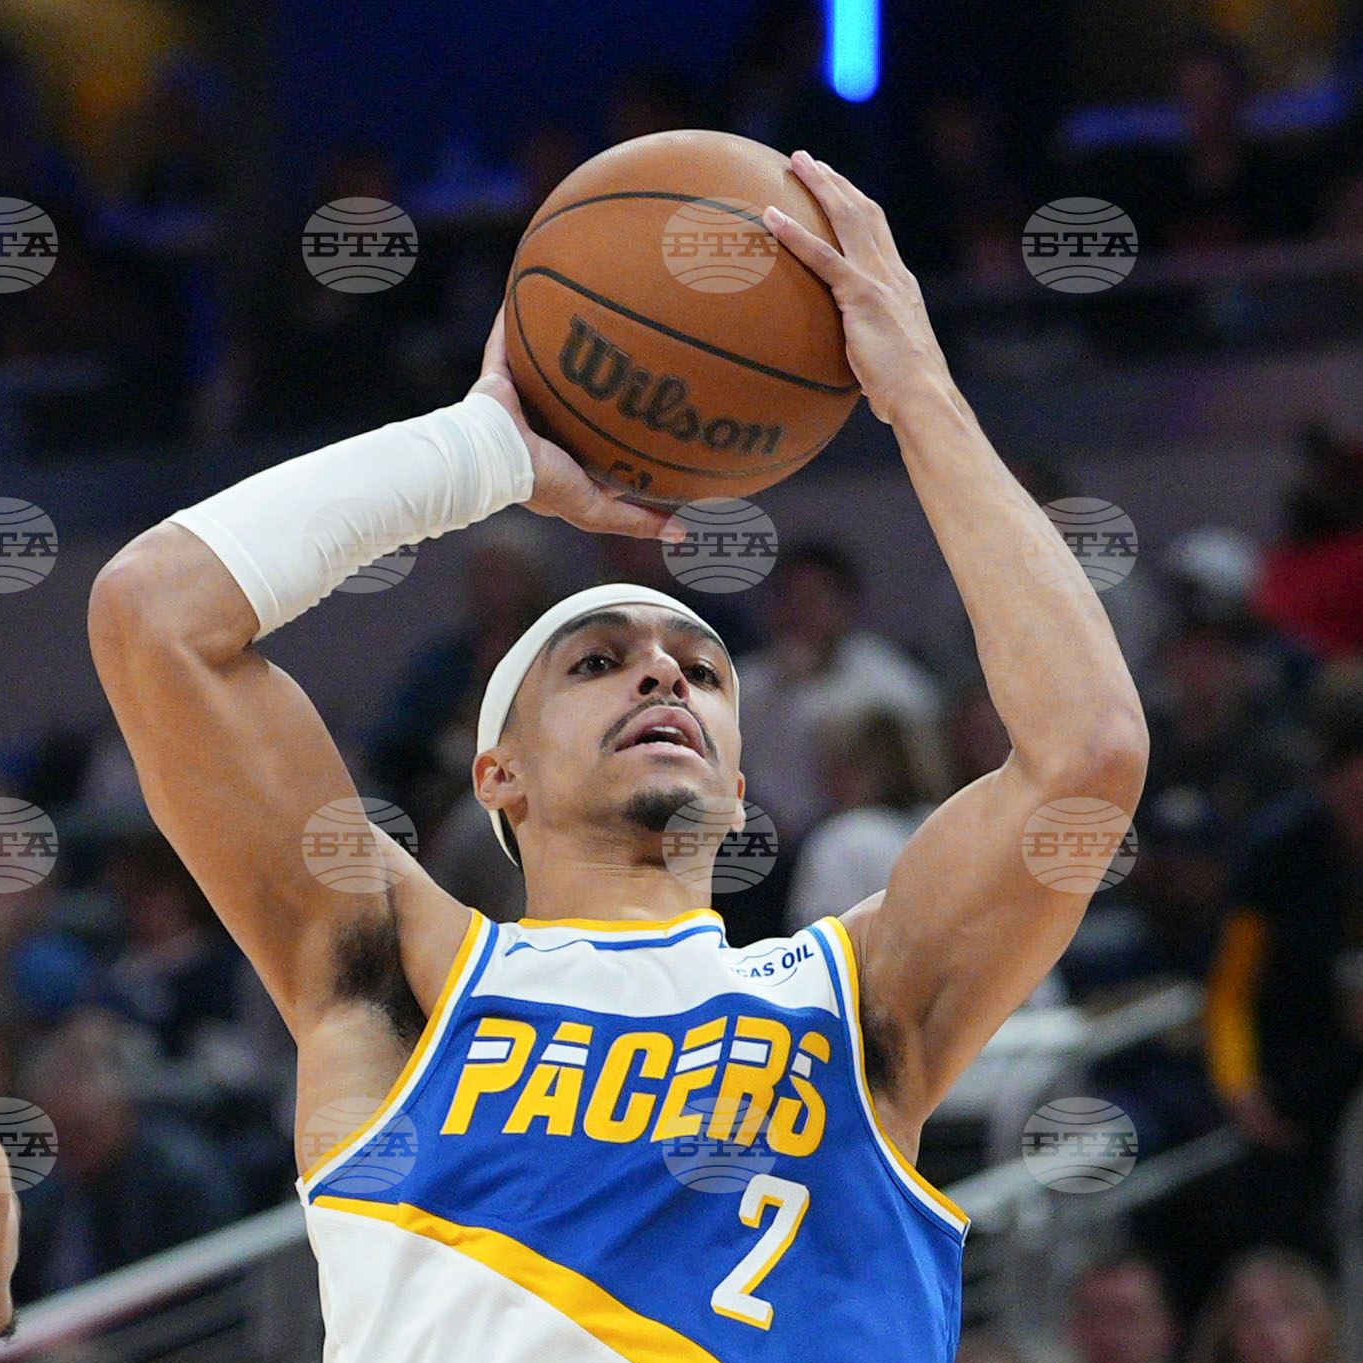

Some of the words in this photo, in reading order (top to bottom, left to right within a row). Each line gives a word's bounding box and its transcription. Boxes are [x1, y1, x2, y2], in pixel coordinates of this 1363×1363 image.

[558, 313, 787, 457] Wilson
[736, 962, 775, 978] CAS
[781, 944, 814, 969] OIL
[440, 1016, 831, 1158] PACERS
[710, 1173, 810, 1331] 2
